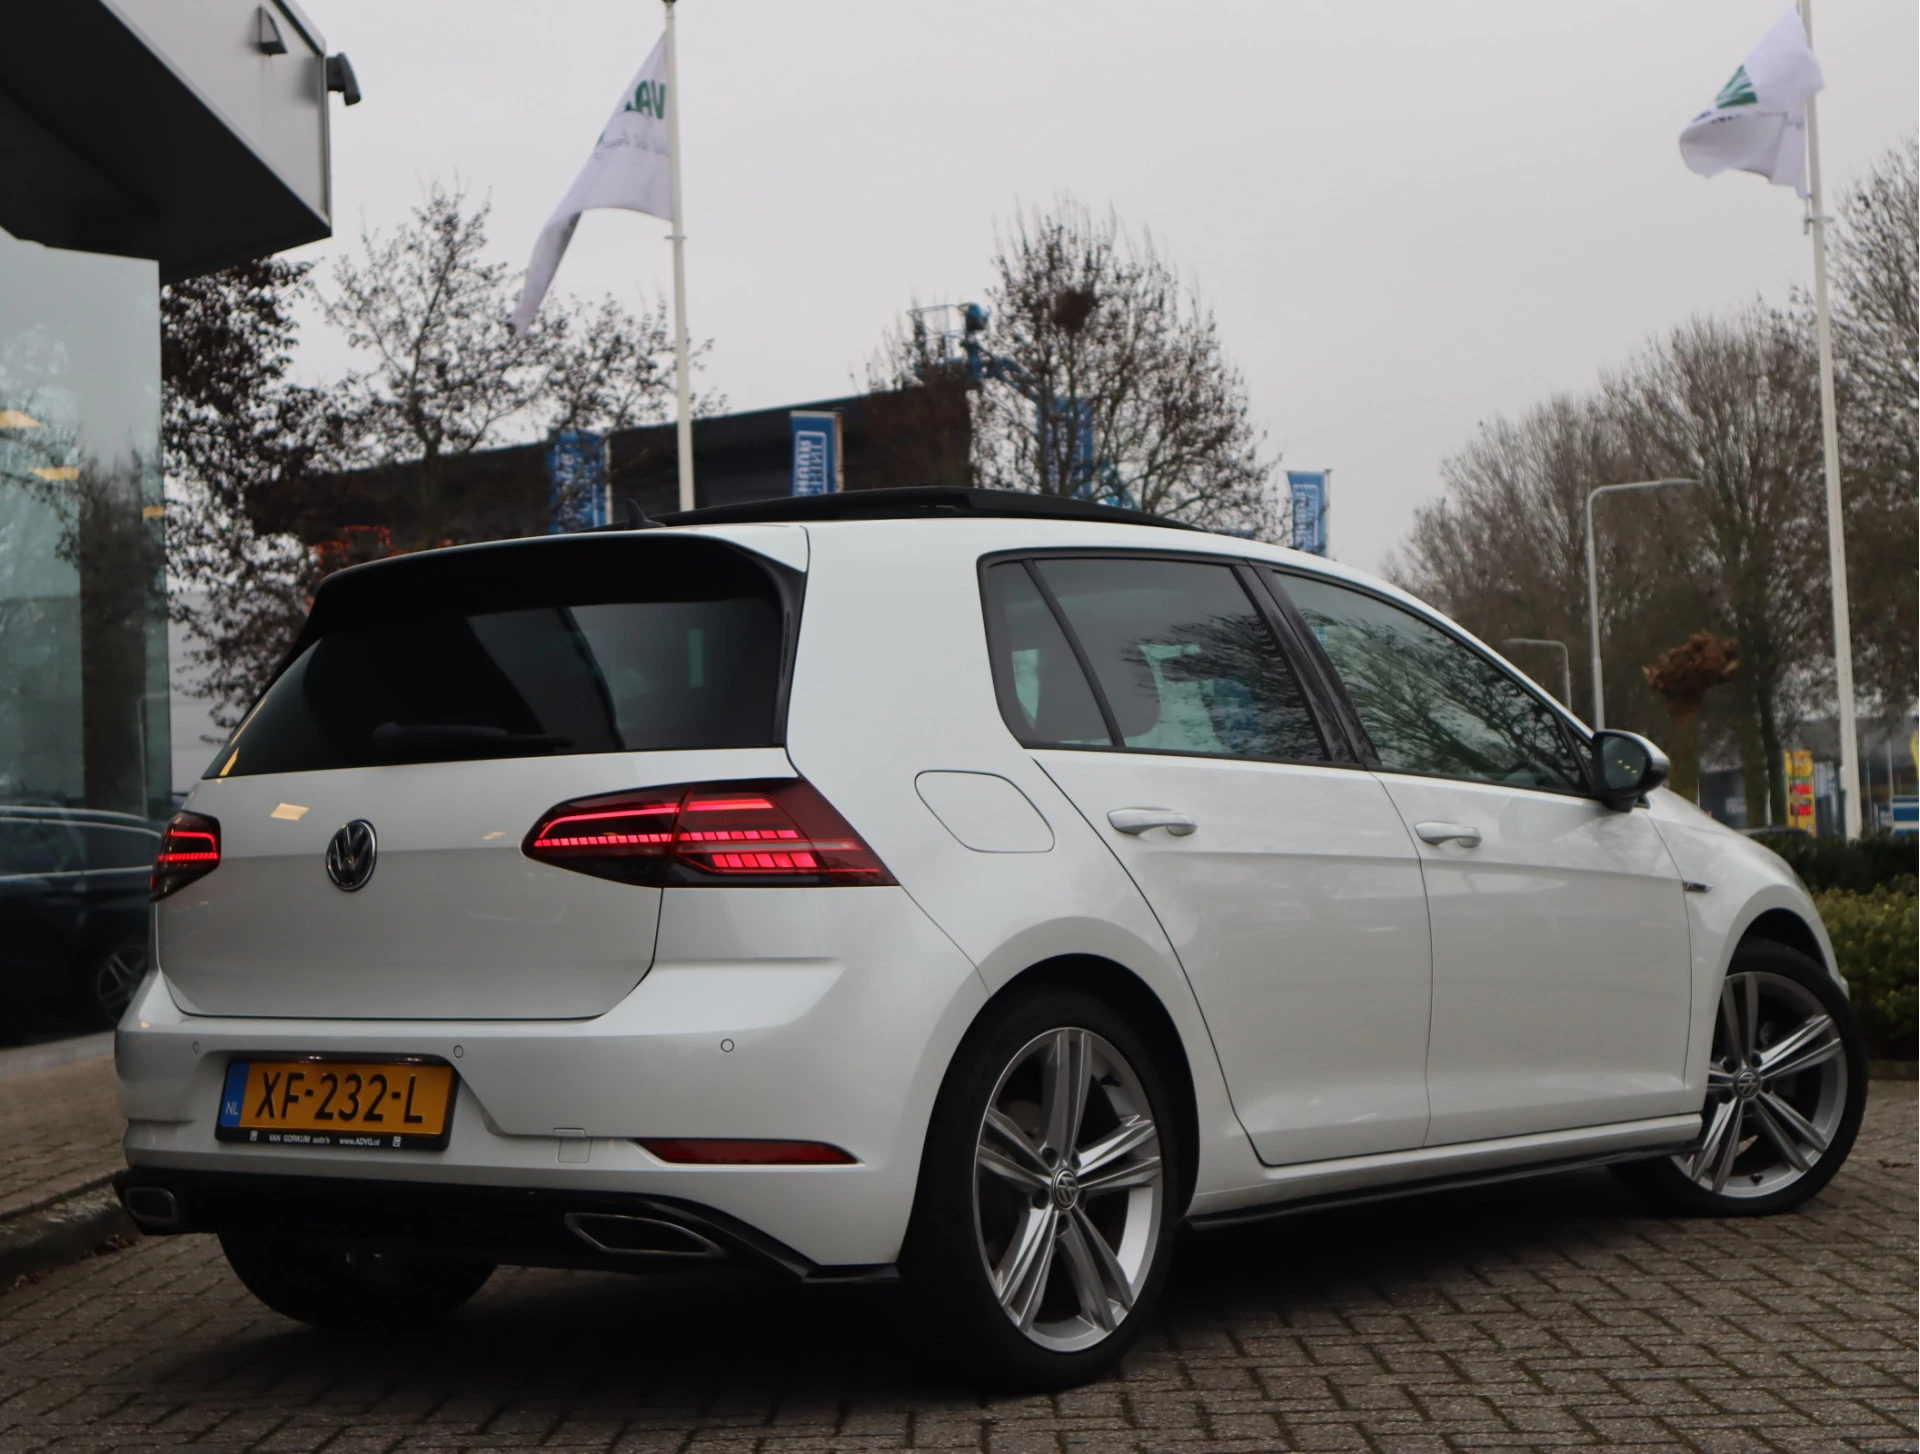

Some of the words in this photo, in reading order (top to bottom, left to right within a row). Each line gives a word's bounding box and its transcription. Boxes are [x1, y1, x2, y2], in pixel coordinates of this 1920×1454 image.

[255, 1071, 424, 1124] XF-232-L
[225, 1101, 239, 1116] NL
[268, 1133, 281, 1142] VAN
[283, 1134, 310, 1144] GORKUM
